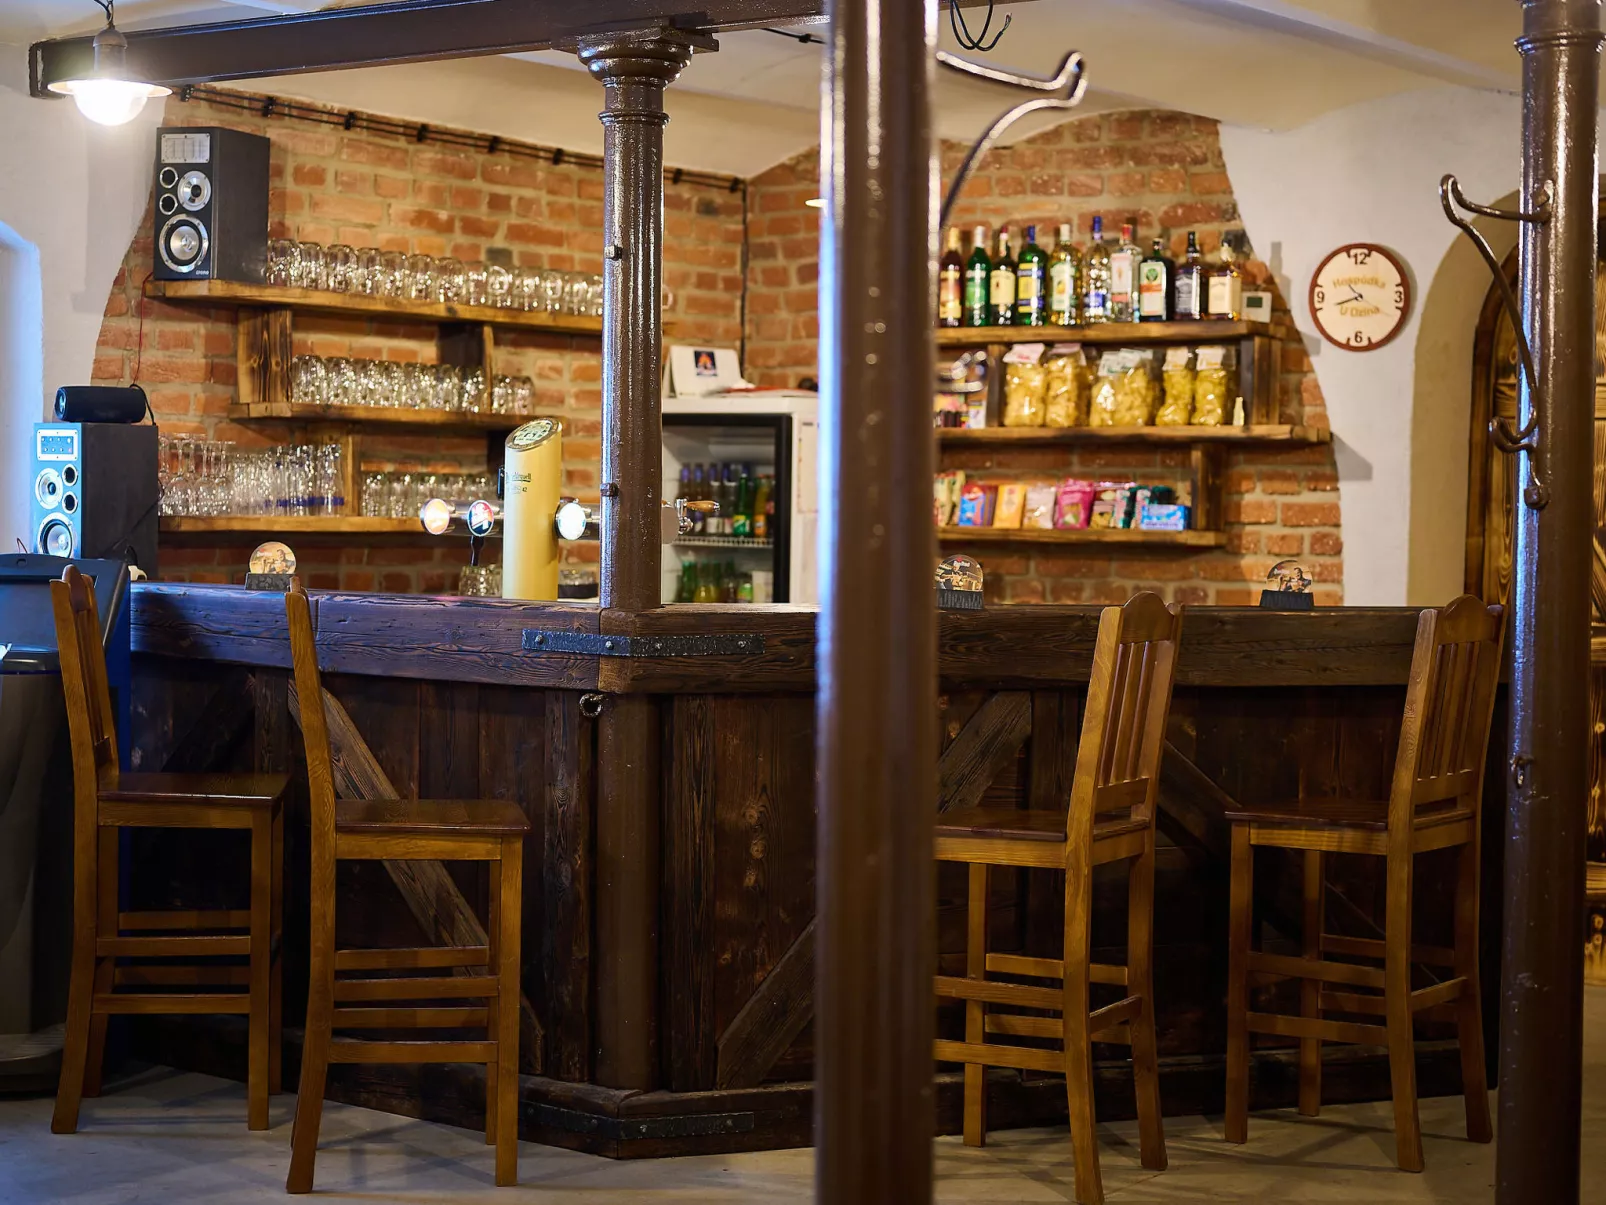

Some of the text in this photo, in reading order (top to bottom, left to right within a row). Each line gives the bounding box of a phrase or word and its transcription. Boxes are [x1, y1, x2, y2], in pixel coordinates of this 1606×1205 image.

[1352, 252, 1368, 265] 12
[1316, 291, 1325, 303] 9
[1394, 291, 1403, 303] 3
[1354, 331, 1363, 344] 6
